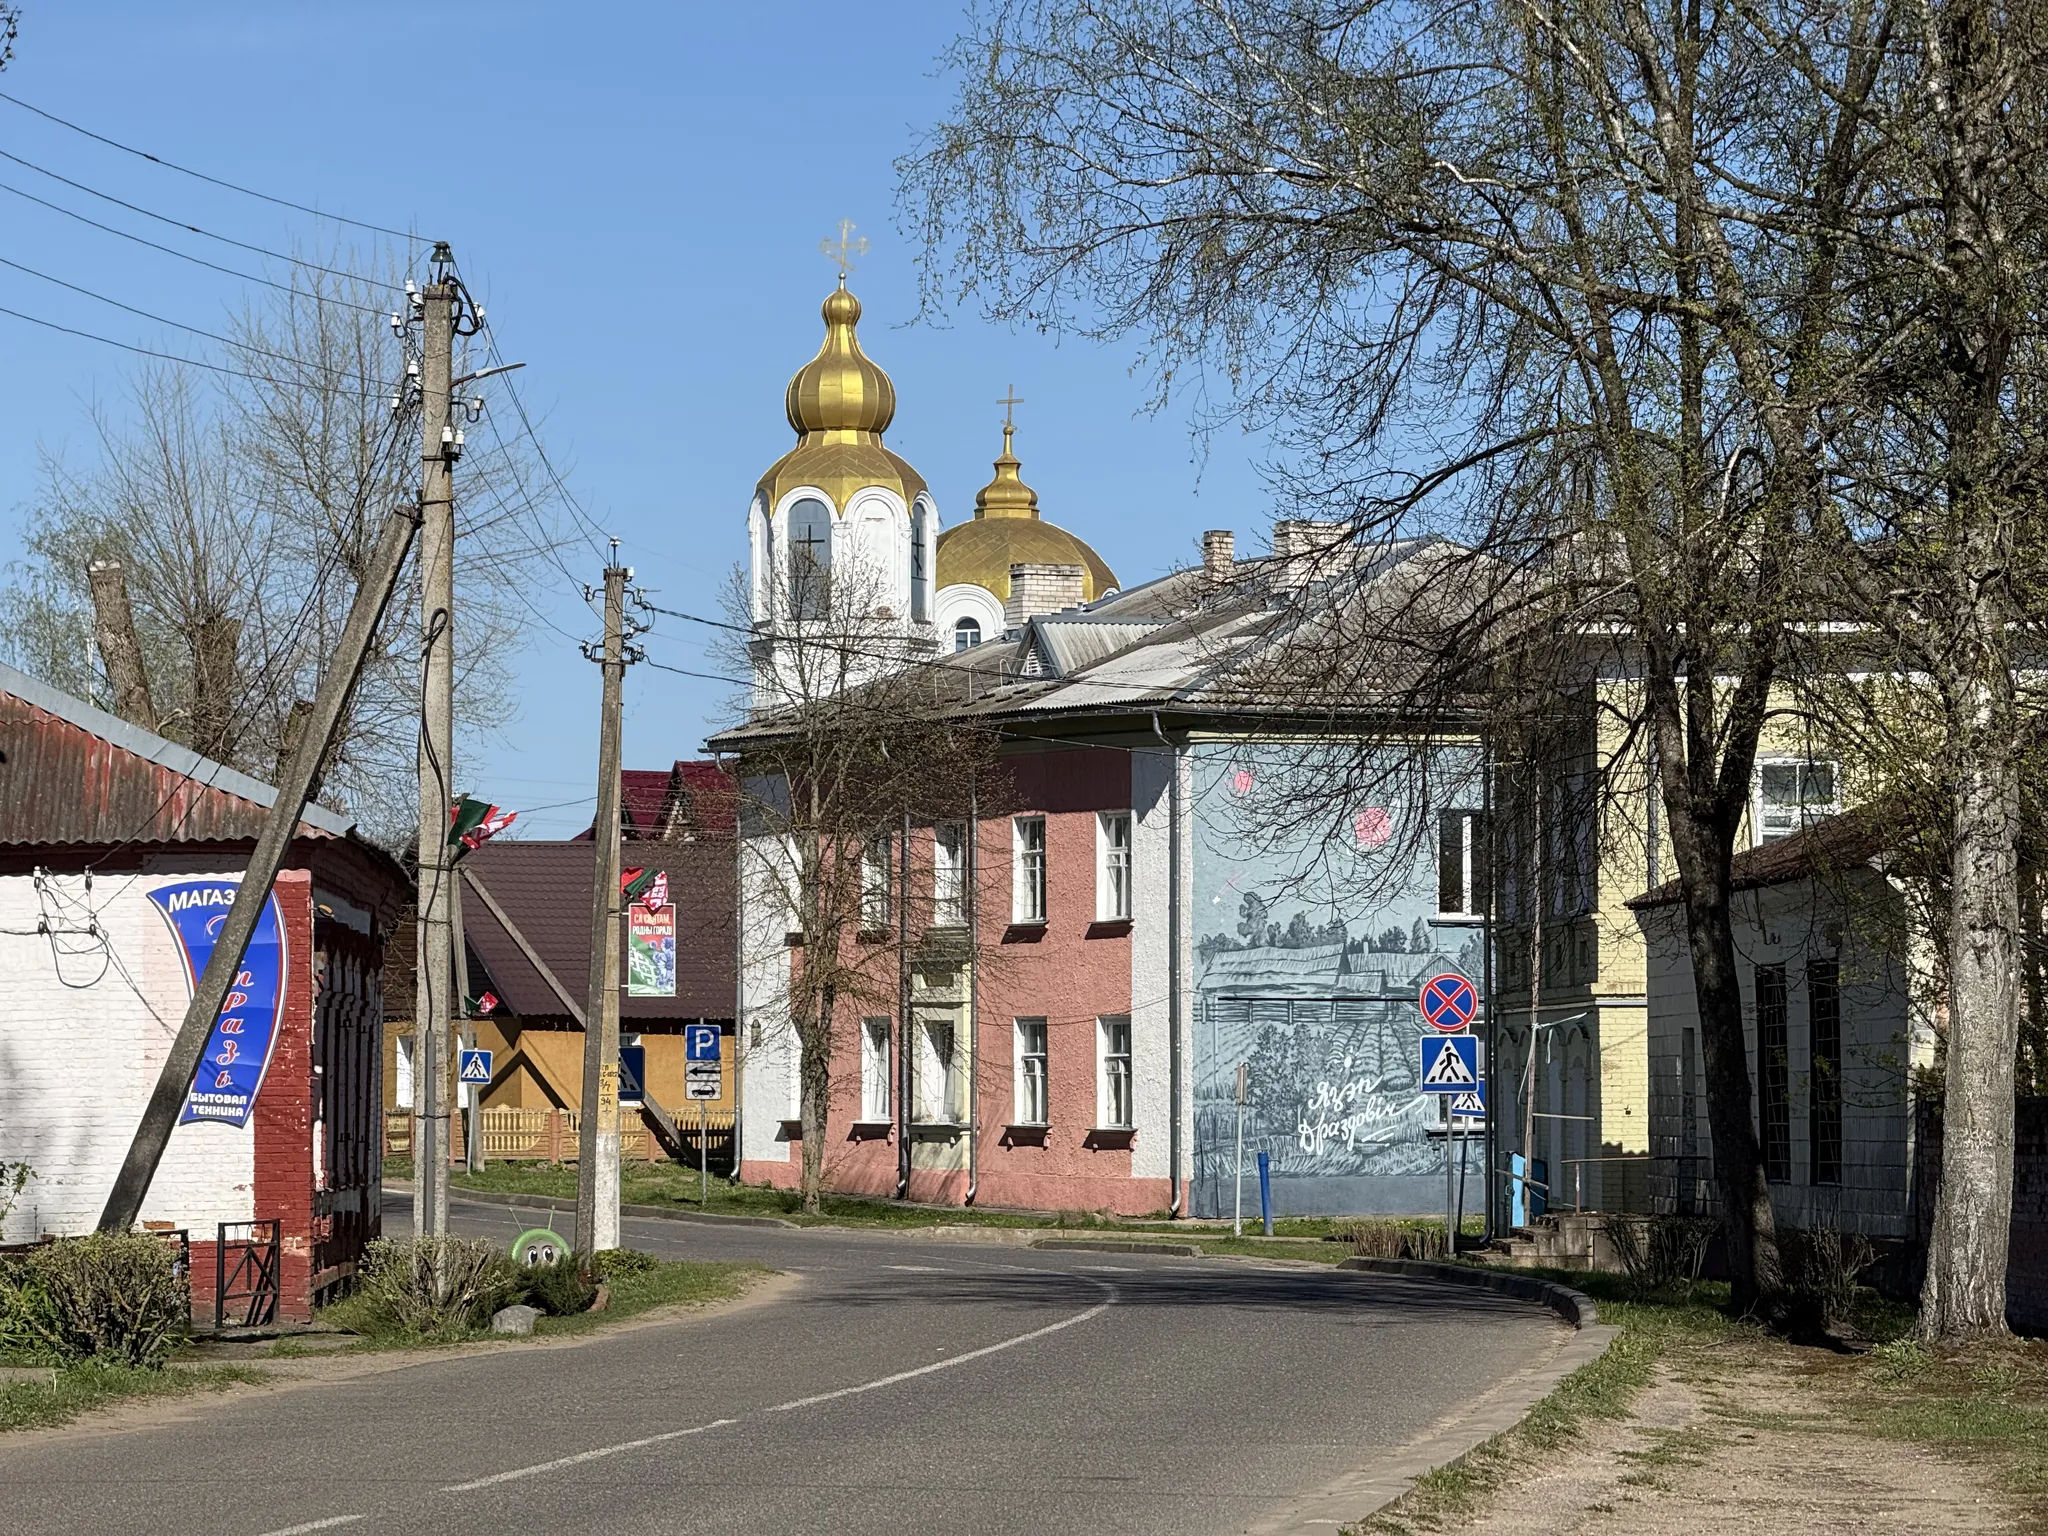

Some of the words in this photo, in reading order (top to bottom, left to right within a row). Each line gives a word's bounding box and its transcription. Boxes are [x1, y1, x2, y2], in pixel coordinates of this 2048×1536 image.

[169, 889, 239, 913] МАГАЗ
[206, 914, 254, 1088] тразь
[696, 1029, 714, 1058] P
[190, 1093, 248, 1105] БЫТОВАЯ
[1308, 1075, 1383, 1112] Язэп
[191, 1104, 244, 1117] ТЕХНИКА
